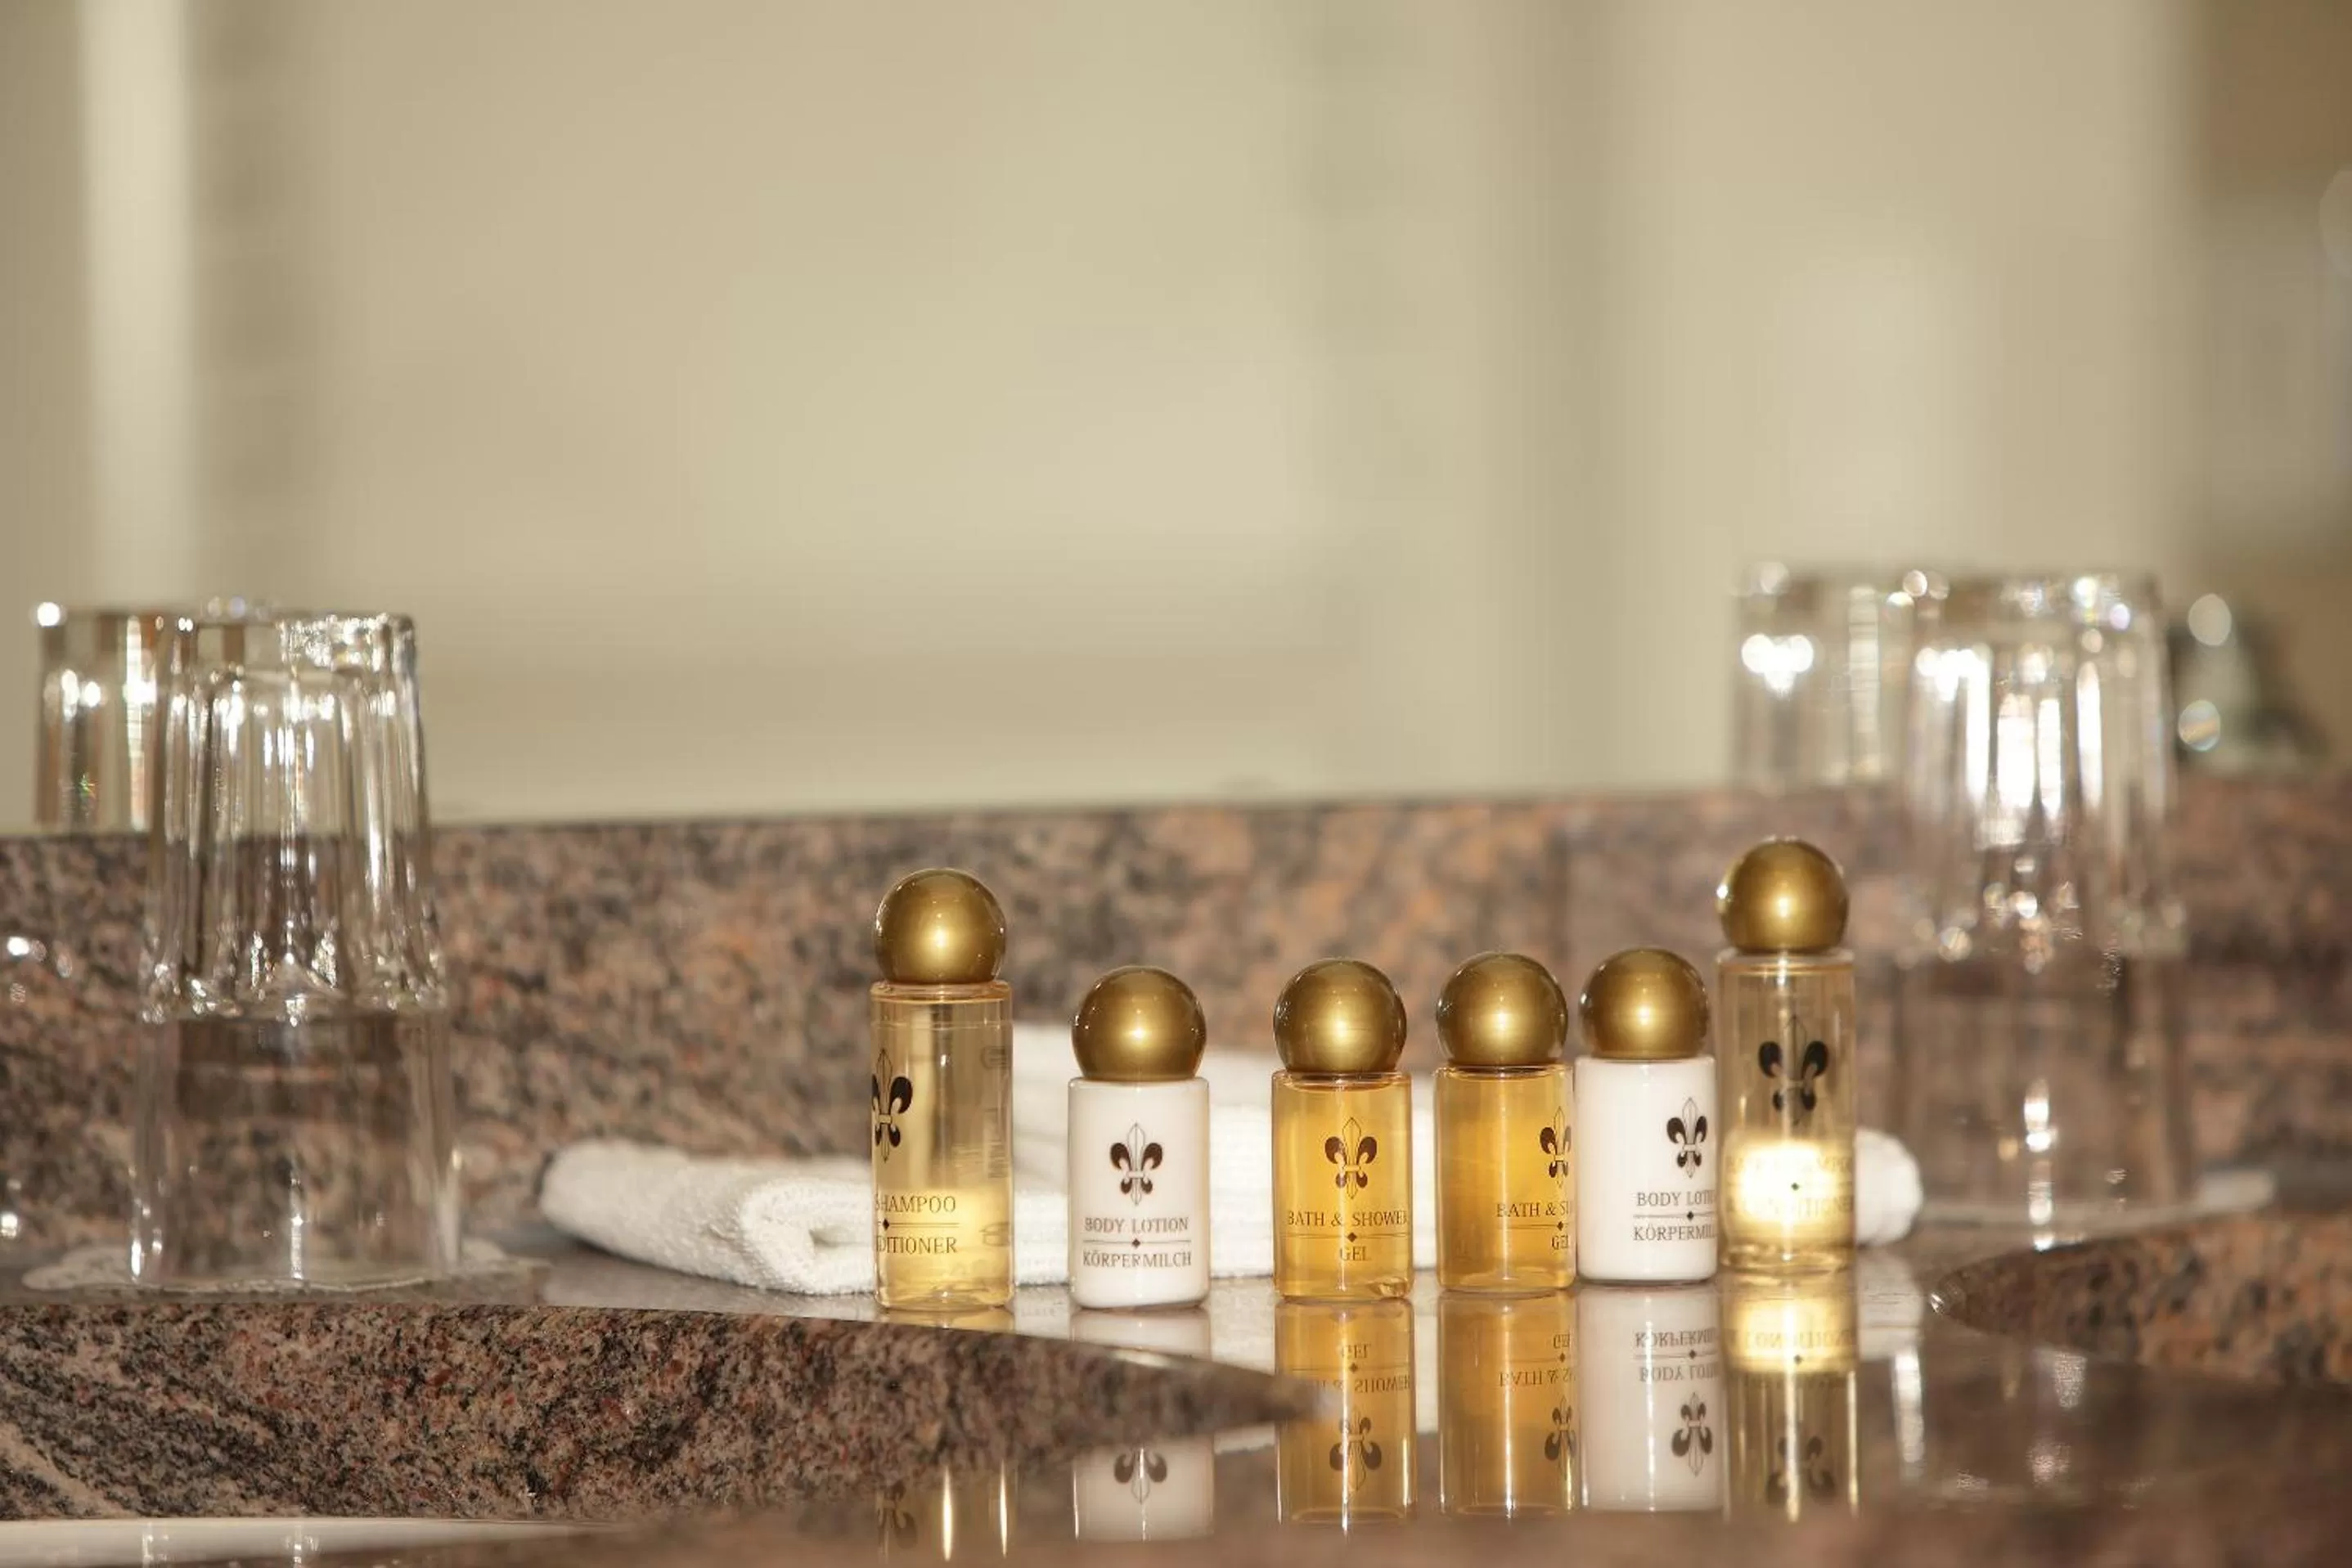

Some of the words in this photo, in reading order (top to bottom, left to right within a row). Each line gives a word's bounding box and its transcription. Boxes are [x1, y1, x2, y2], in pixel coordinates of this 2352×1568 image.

[1636, 1191, 1682, 1207] BODY
[1685, 1189, 1717, 1206] LOTI
[1288, 1210, 1324, 1227] BATH
[1330, 1211, 1342, 1227] &
[1496, 1202, 1540, 1218] BATH
[1545, 1202, 1556, 1216] &
[1084, 1216, 1125, 1234] BODY
[1131, 1216, 1189, 1234] LOTION
[1633, 1223, 1718, 1242] KÖRPERMIL
[1082, 1249, 1192, 1268] KÖRPERMILCH
[1339, 1246, 1372, 1262] GEL
